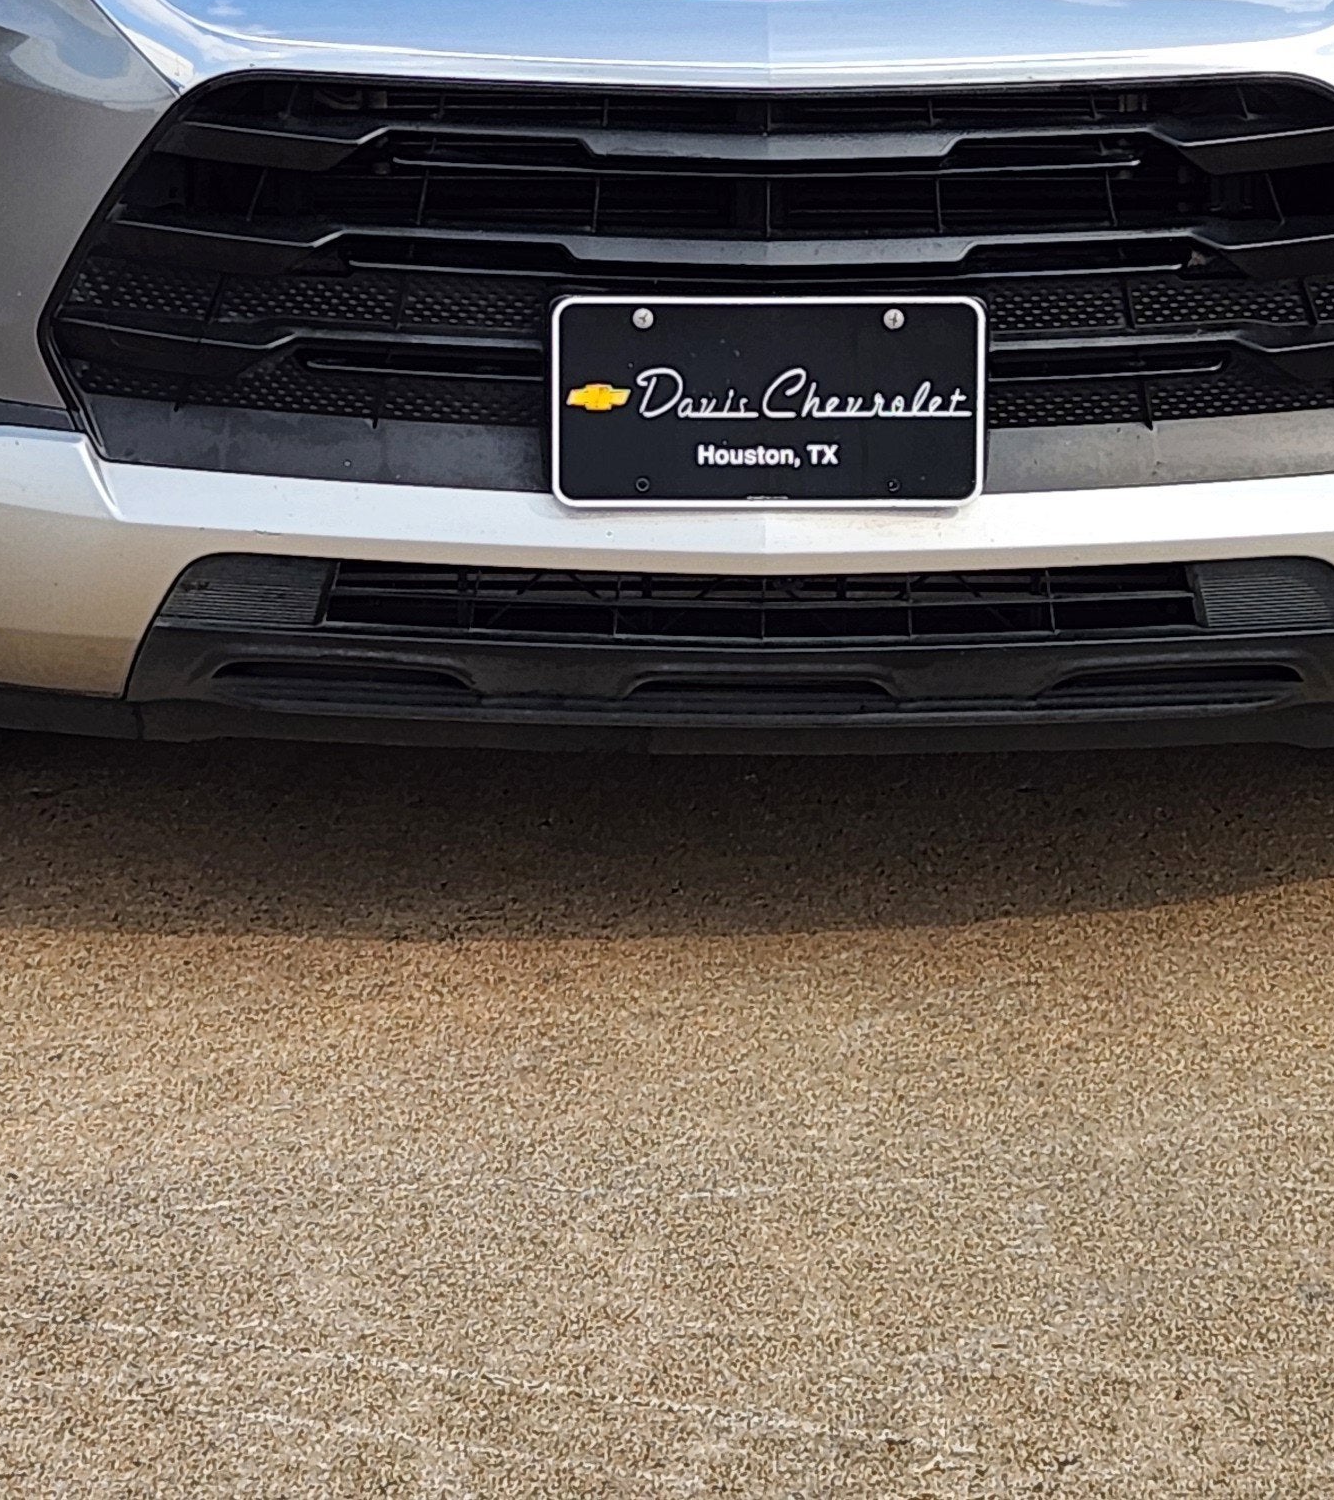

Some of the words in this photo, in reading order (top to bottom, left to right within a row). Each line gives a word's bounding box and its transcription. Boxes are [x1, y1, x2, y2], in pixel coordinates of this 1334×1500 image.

[635, 367, 759, 418] Davis
[761, 367, 972, 418] Chevrolet
[696, 444, 801, 469] Houston,
[806, 444, 840, 466] TX
